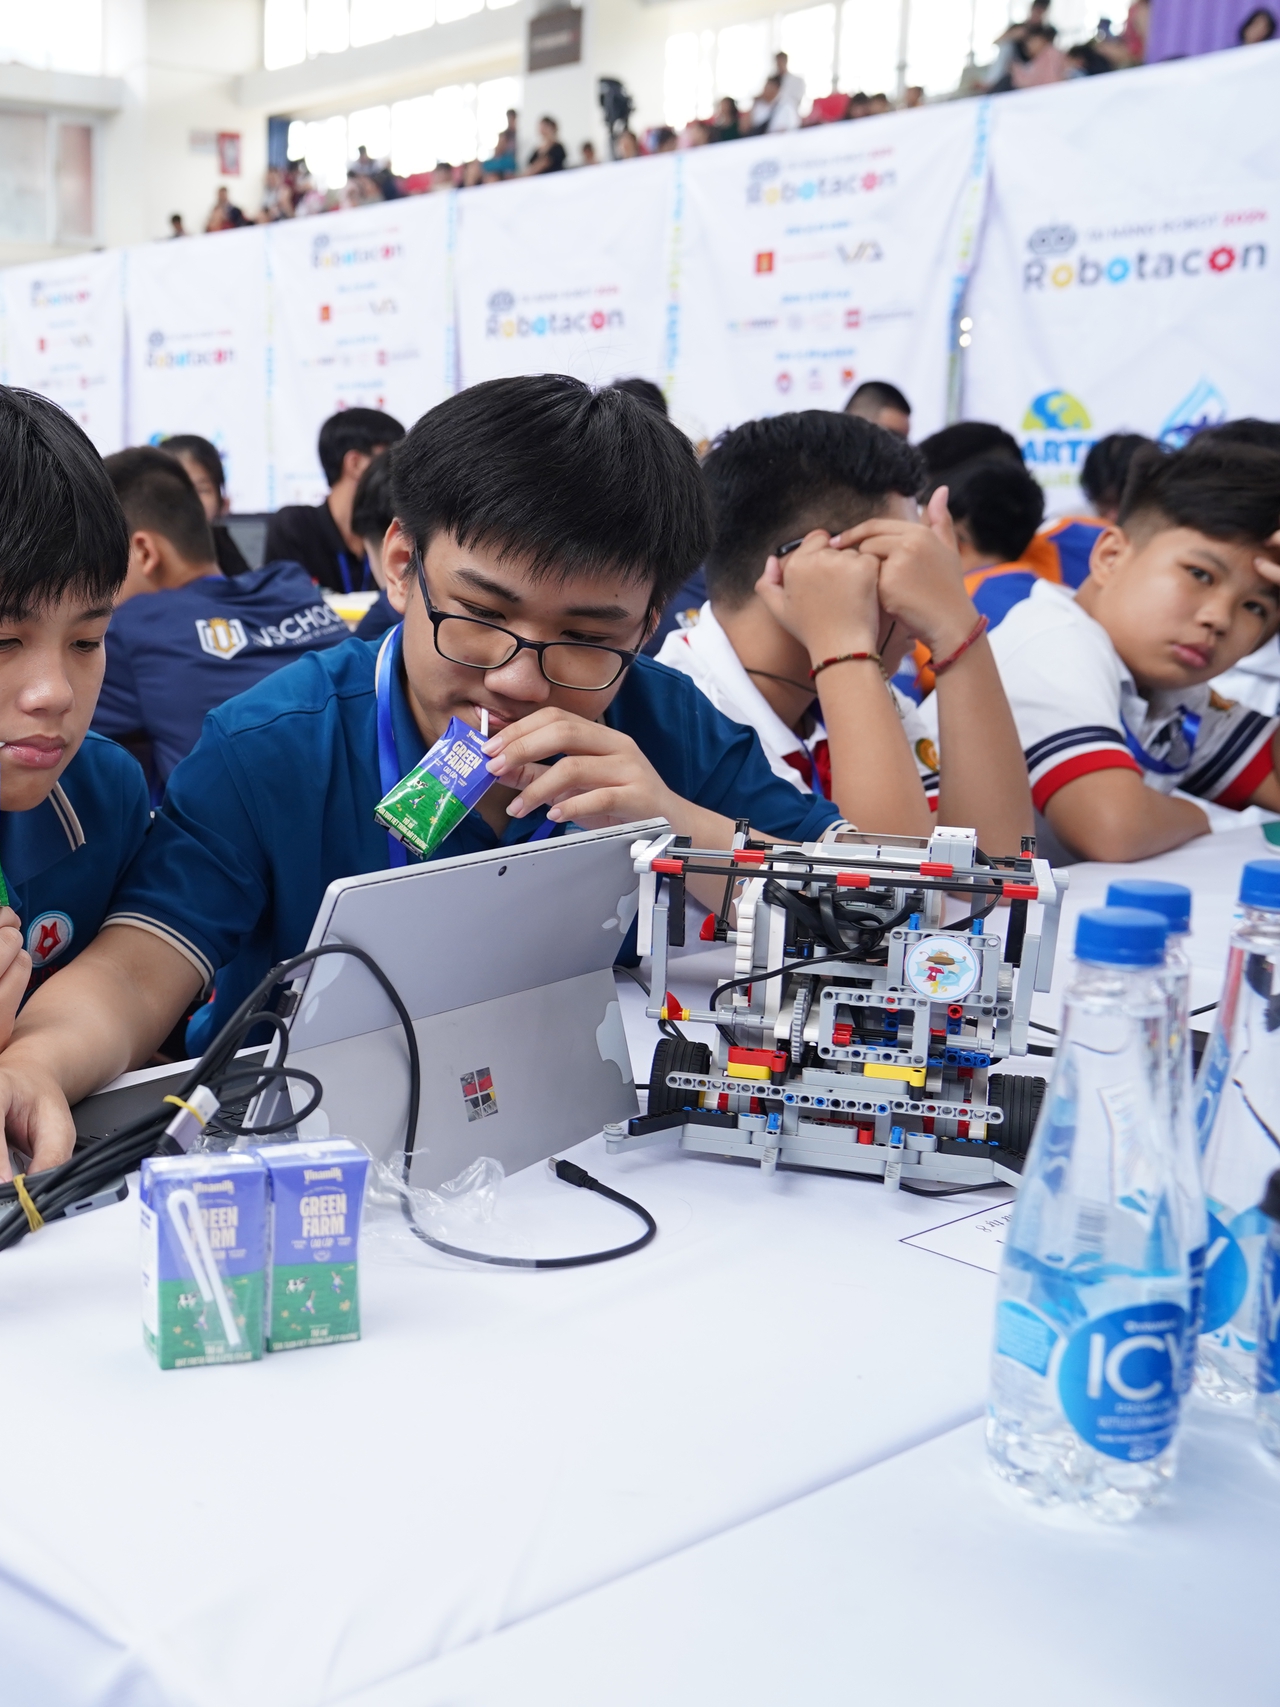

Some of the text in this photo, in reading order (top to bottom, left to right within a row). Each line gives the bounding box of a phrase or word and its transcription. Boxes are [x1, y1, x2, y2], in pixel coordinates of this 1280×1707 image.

[1023, 242, 1267, 291] Robotacon
[486, 309, 624, 339] Robotacon
[251, 604, 340, 647] VSCHOO
[443, 750, 474, 778] FARM
[452, 741, 483, 769] GREEN
[303, 1167, 342, 1185] Vinamilk
[187, 1206, 238, 1229] REEN
[300, 1193, 347, 1217] GREEN
[302, 1214, 345, 1238] FARM
